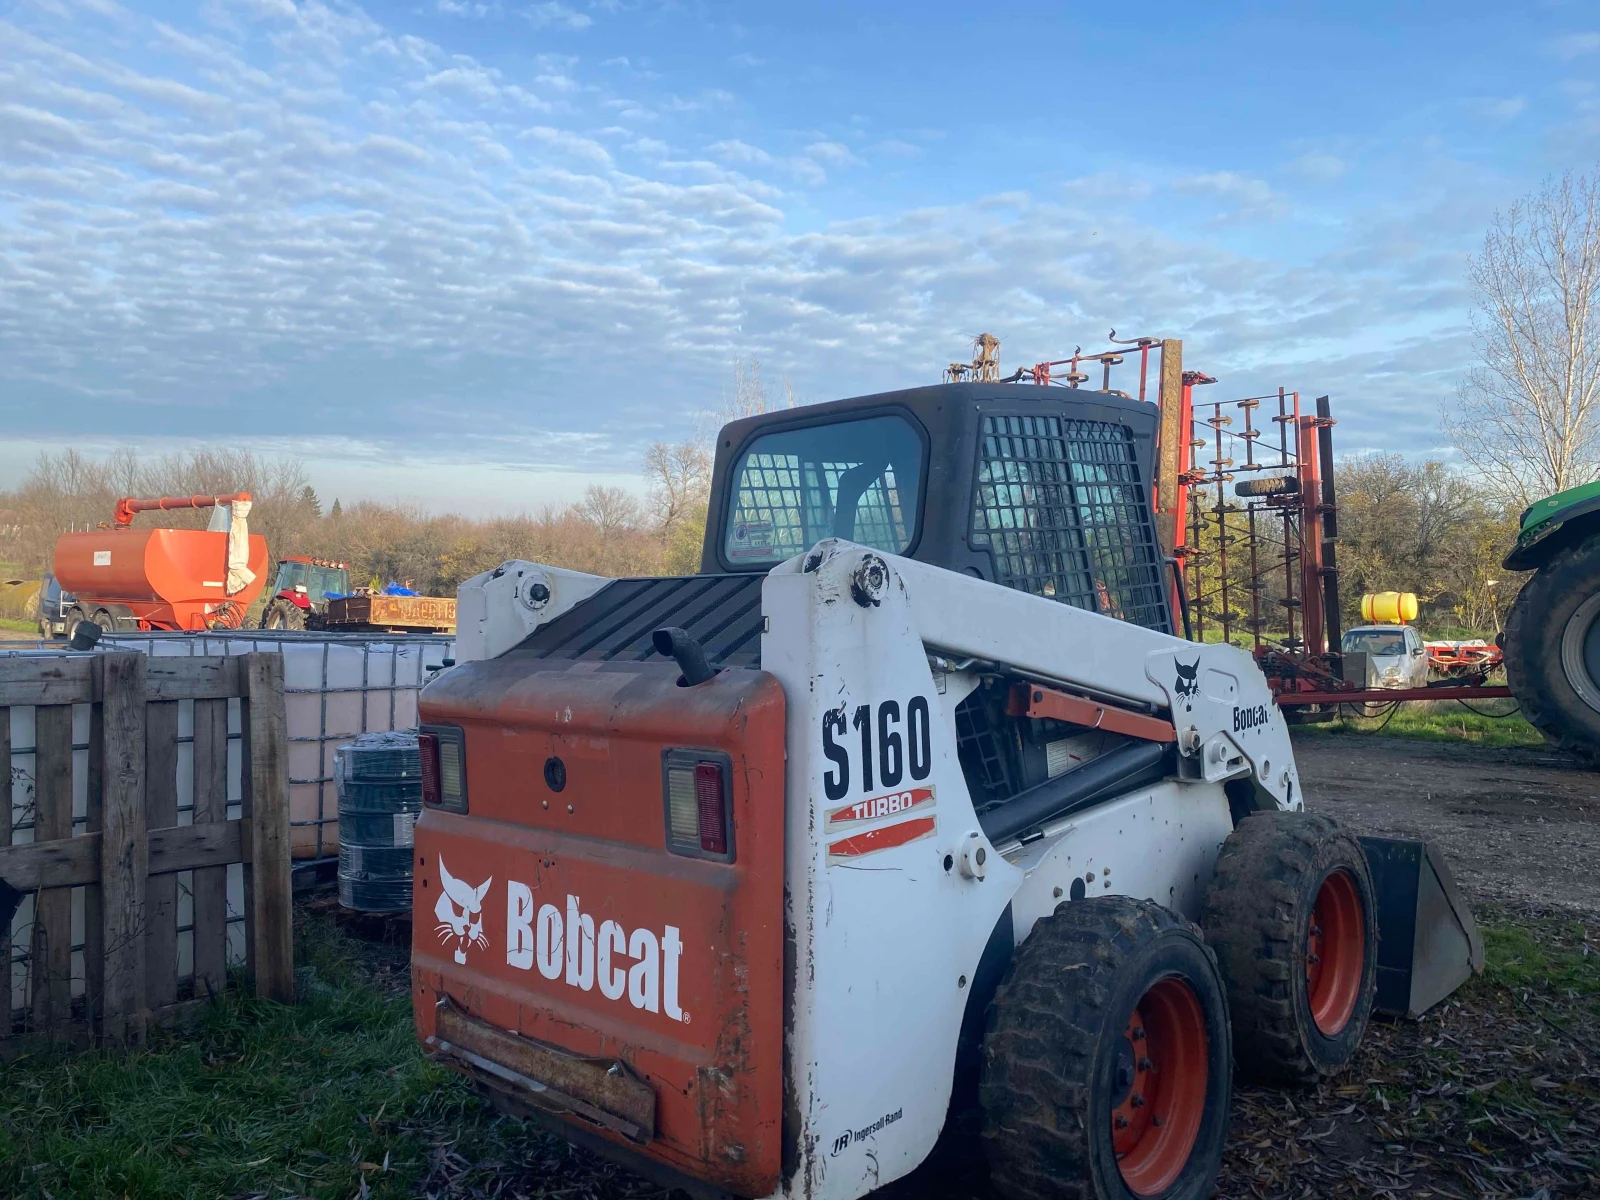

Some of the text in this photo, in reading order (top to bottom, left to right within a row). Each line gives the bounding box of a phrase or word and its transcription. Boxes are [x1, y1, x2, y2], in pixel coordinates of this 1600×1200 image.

[822, 695, 932, 801] S160
[852, 792, 913, 819] TURBO
[854, 1117, 884, 1142] Ingersoll
